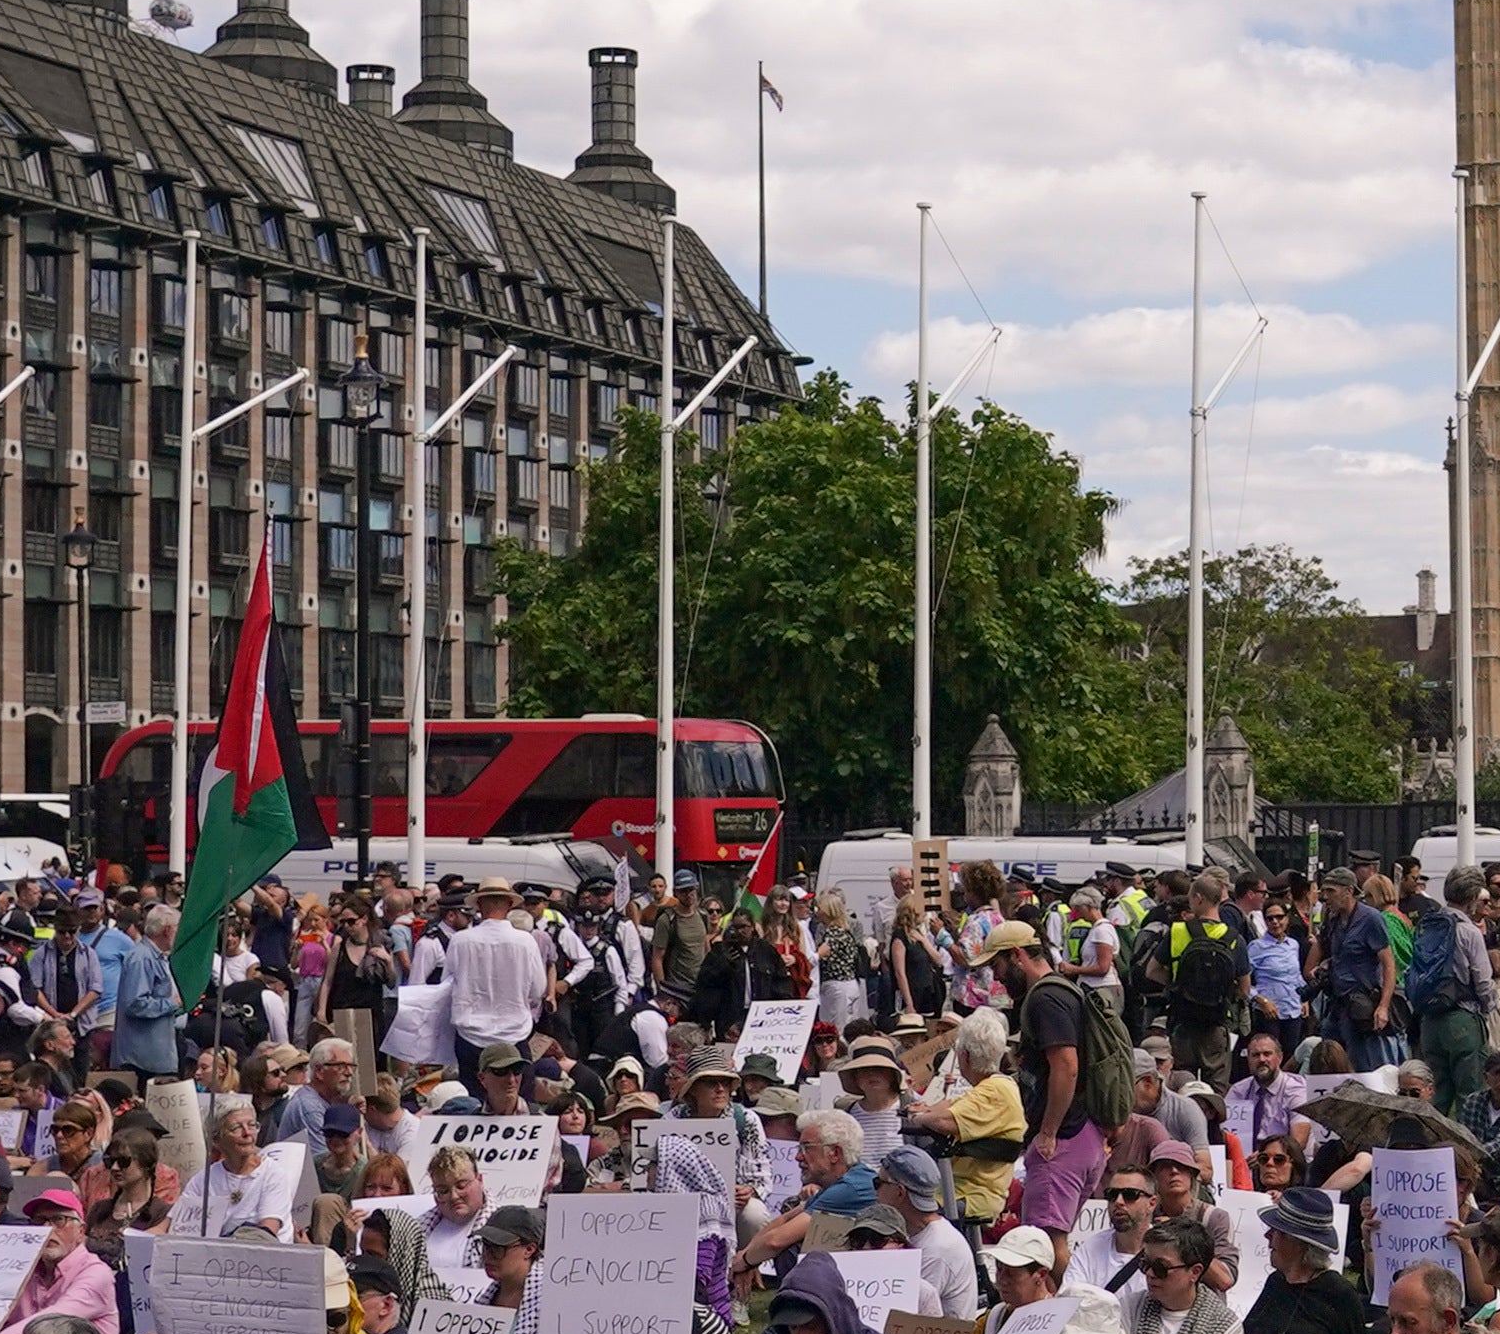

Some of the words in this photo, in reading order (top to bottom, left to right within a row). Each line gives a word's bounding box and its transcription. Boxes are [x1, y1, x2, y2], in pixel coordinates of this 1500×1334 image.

[753, 812, 768, 831] 26
[765, 1005, 804, 1016] OPPOSE
[453, 1124, 542, 1143] OPPOSE
[1385, 1170, 1447, 1196] OPPOSE
[581, 1209, 666, 1233] OPPOSE
[1388, 1233, 1450, 1253] SUPPORT
[170, 1253, 183, 1285] I
[204, 1258, 292, 1290] OPPOSE
[550, 1256, 677, 1285] GENOCIDE
[191, 1292, 290, 1320] GENOCIDE
